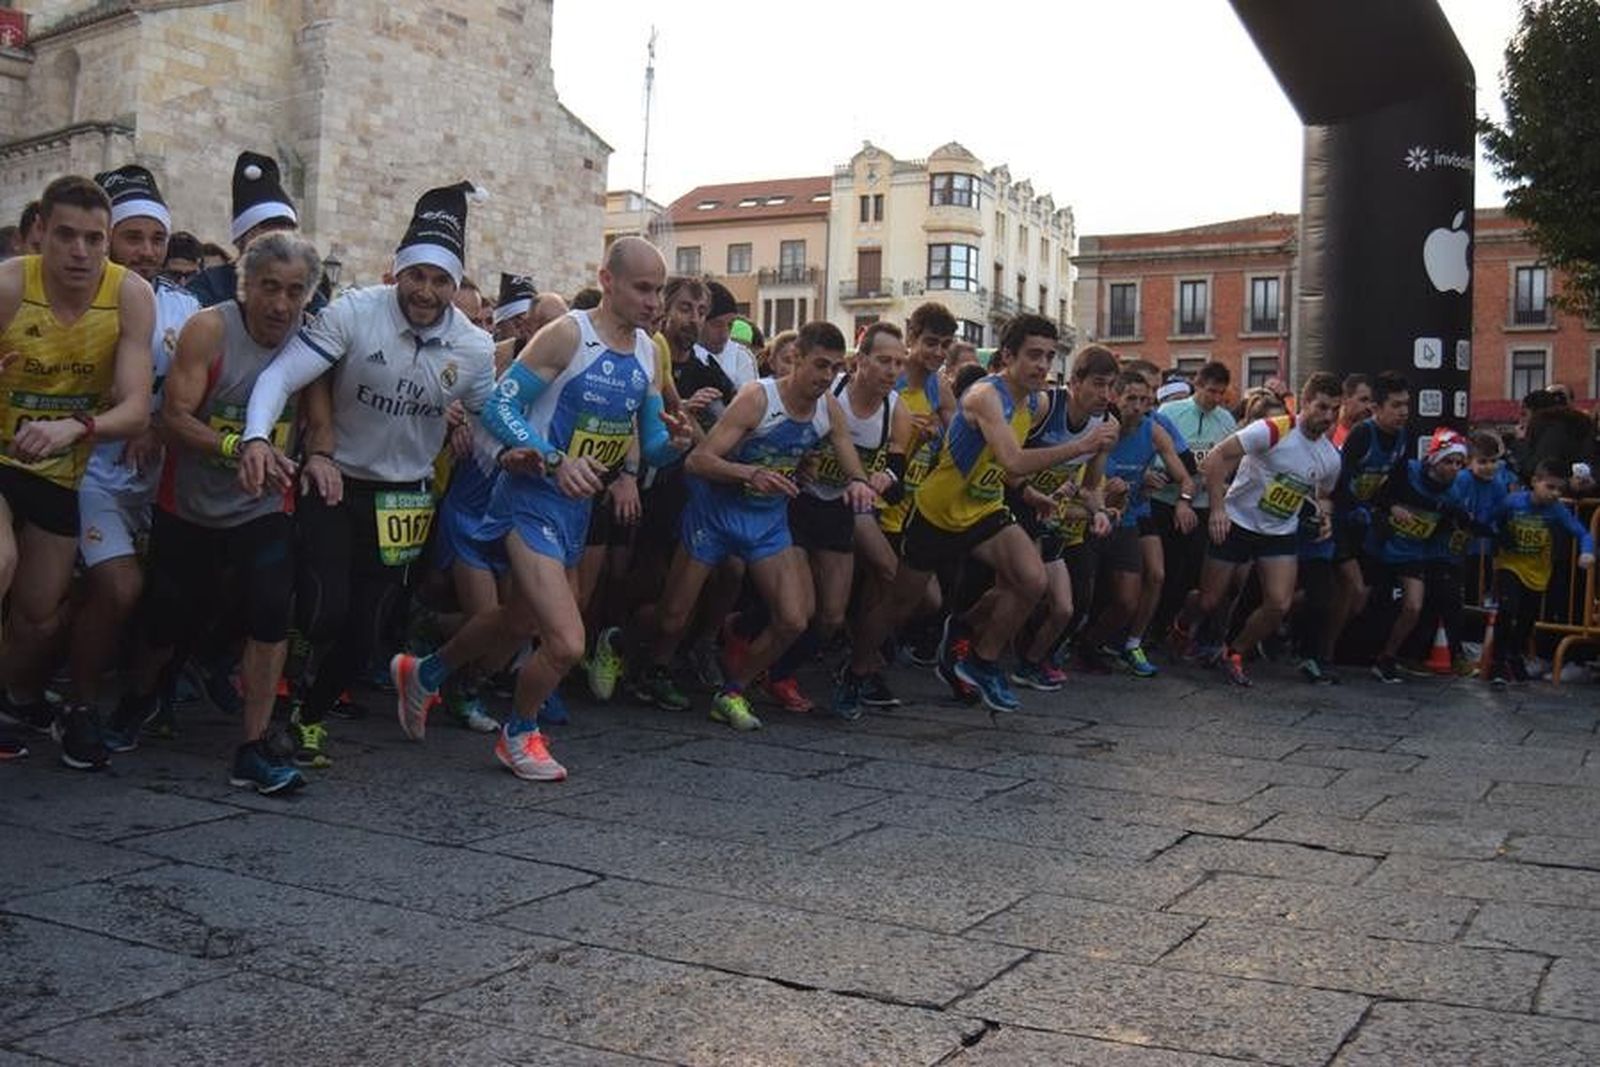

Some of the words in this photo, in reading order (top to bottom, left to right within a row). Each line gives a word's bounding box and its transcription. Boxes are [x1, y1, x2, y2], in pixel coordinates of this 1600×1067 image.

[356, 383, 444, 417] Emirates
[396, 378, 425, 400] Fly
[388, 513, 431, 543] 0167
